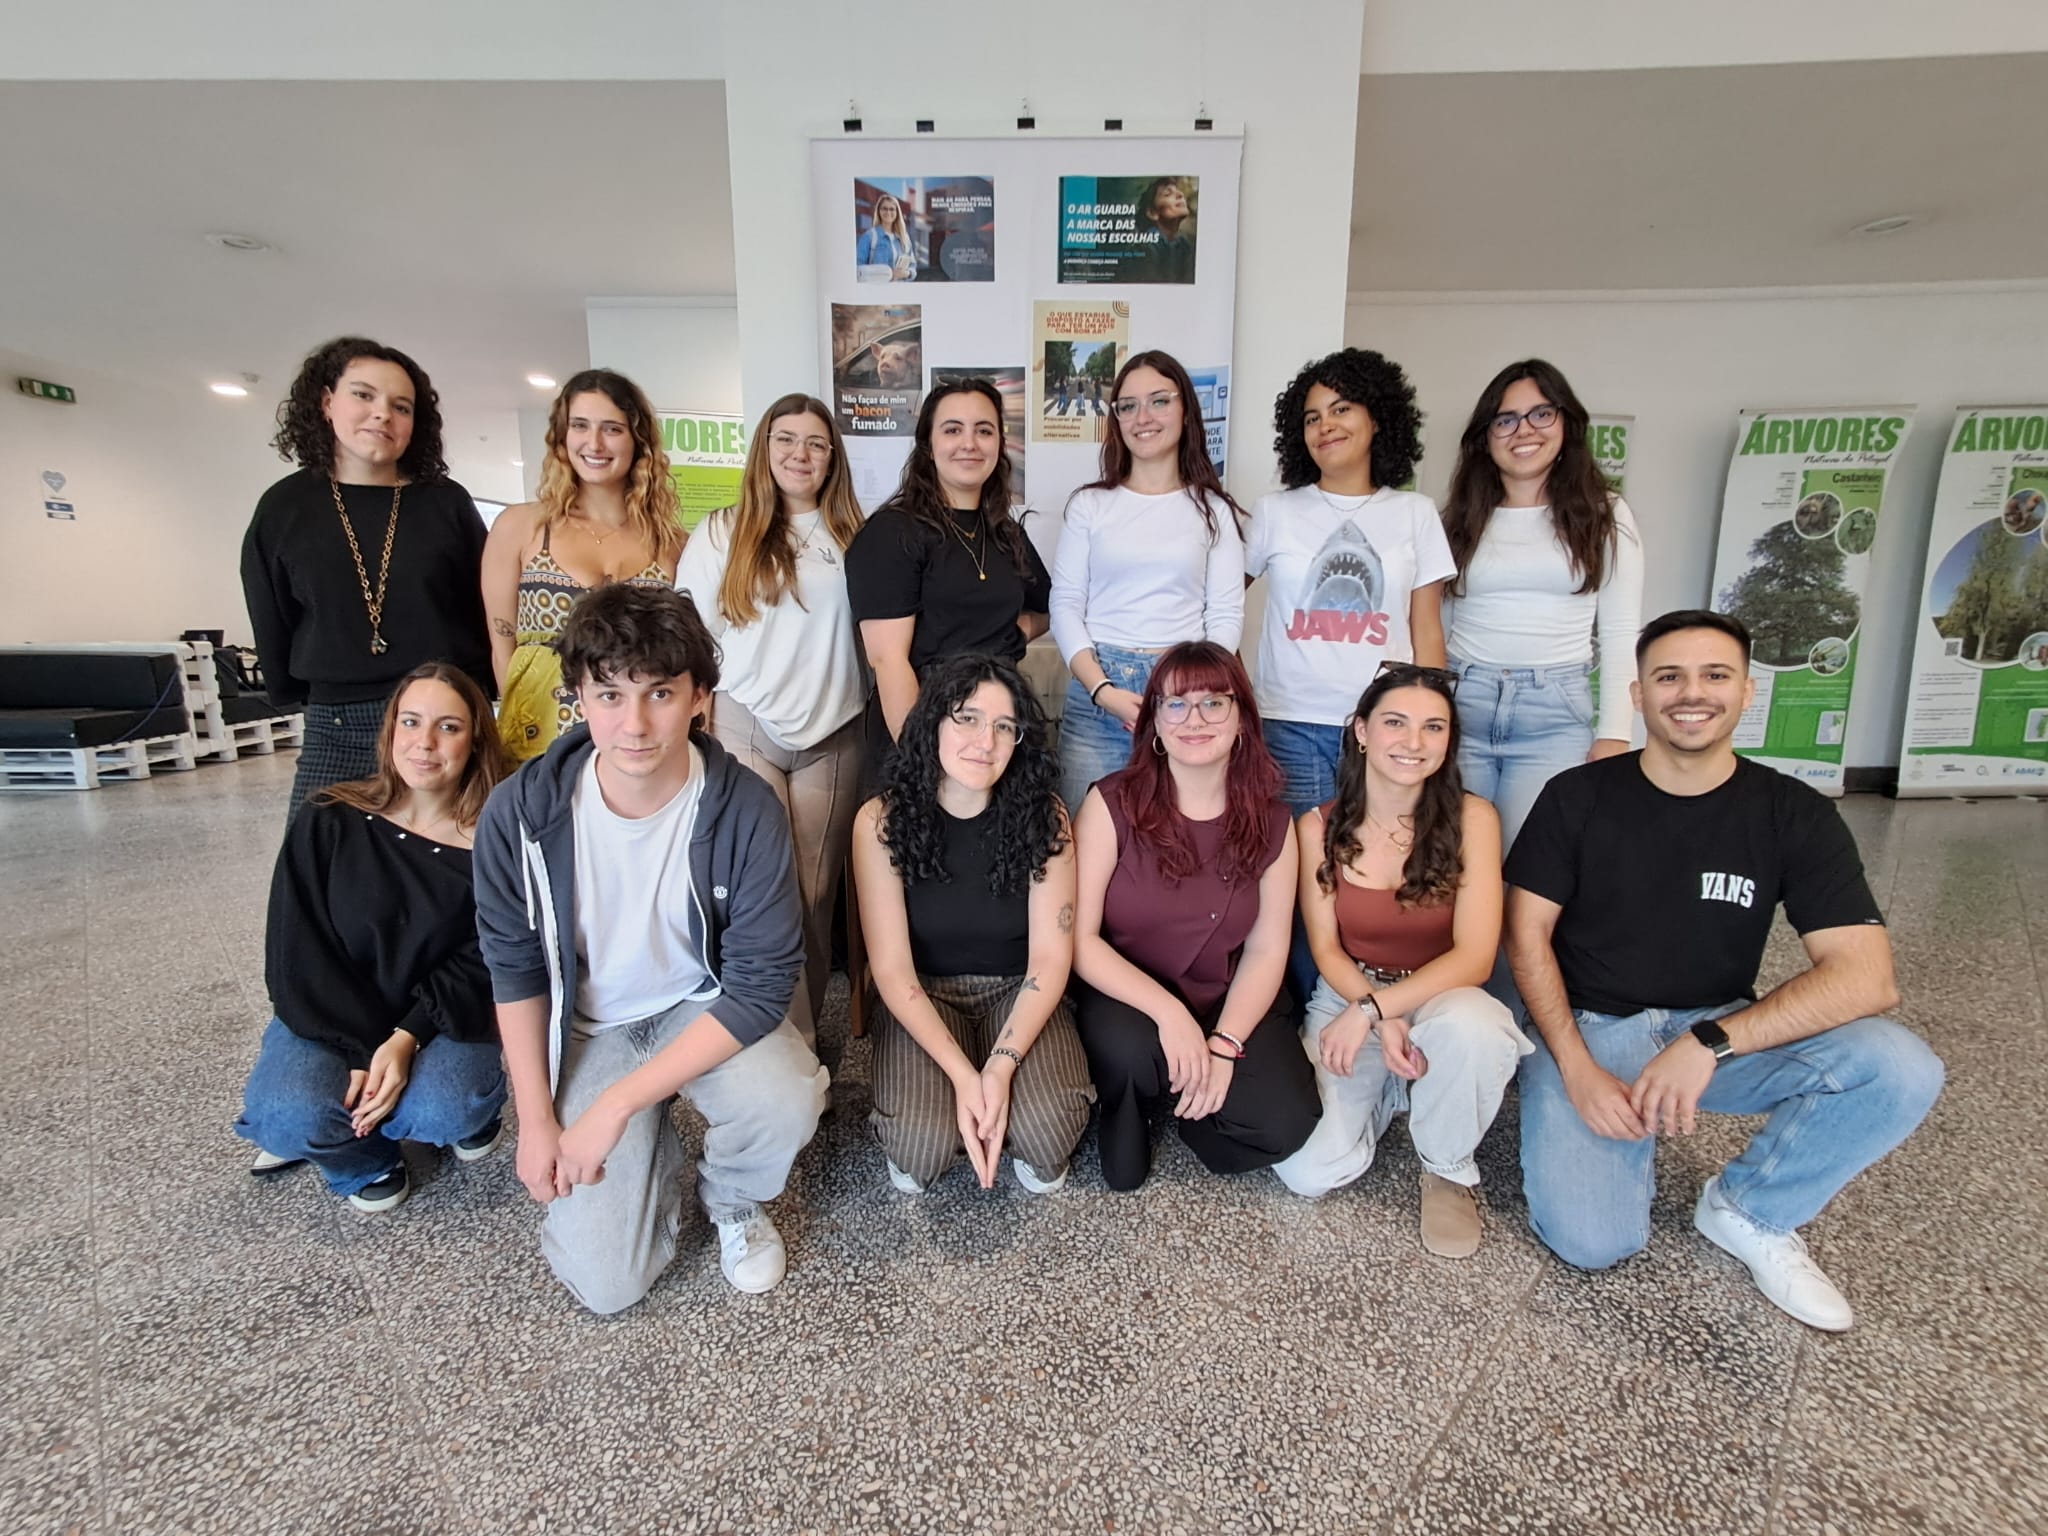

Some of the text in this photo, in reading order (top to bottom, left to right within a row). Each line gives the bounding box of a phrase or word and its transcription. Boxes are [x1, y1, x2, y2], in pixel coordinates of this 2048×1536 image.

[1068, 204, 1136, 215] O AR GUARDA
[1067, 219, 1136, 230] A MARCA DAS
[1067, 232, 1160, 243] NOSSAS ESCOLHAS
[841, 393, 907, 406] Não faças de mim
[841, 404, 892, 416] um bacon
[851, 416, 897, 430] fumado
[1740, 413, 1905, 455] ÁRVORES
[1286, 609, 1390, 646] JAWS
[1700, 872, 1756, 909] VANS
